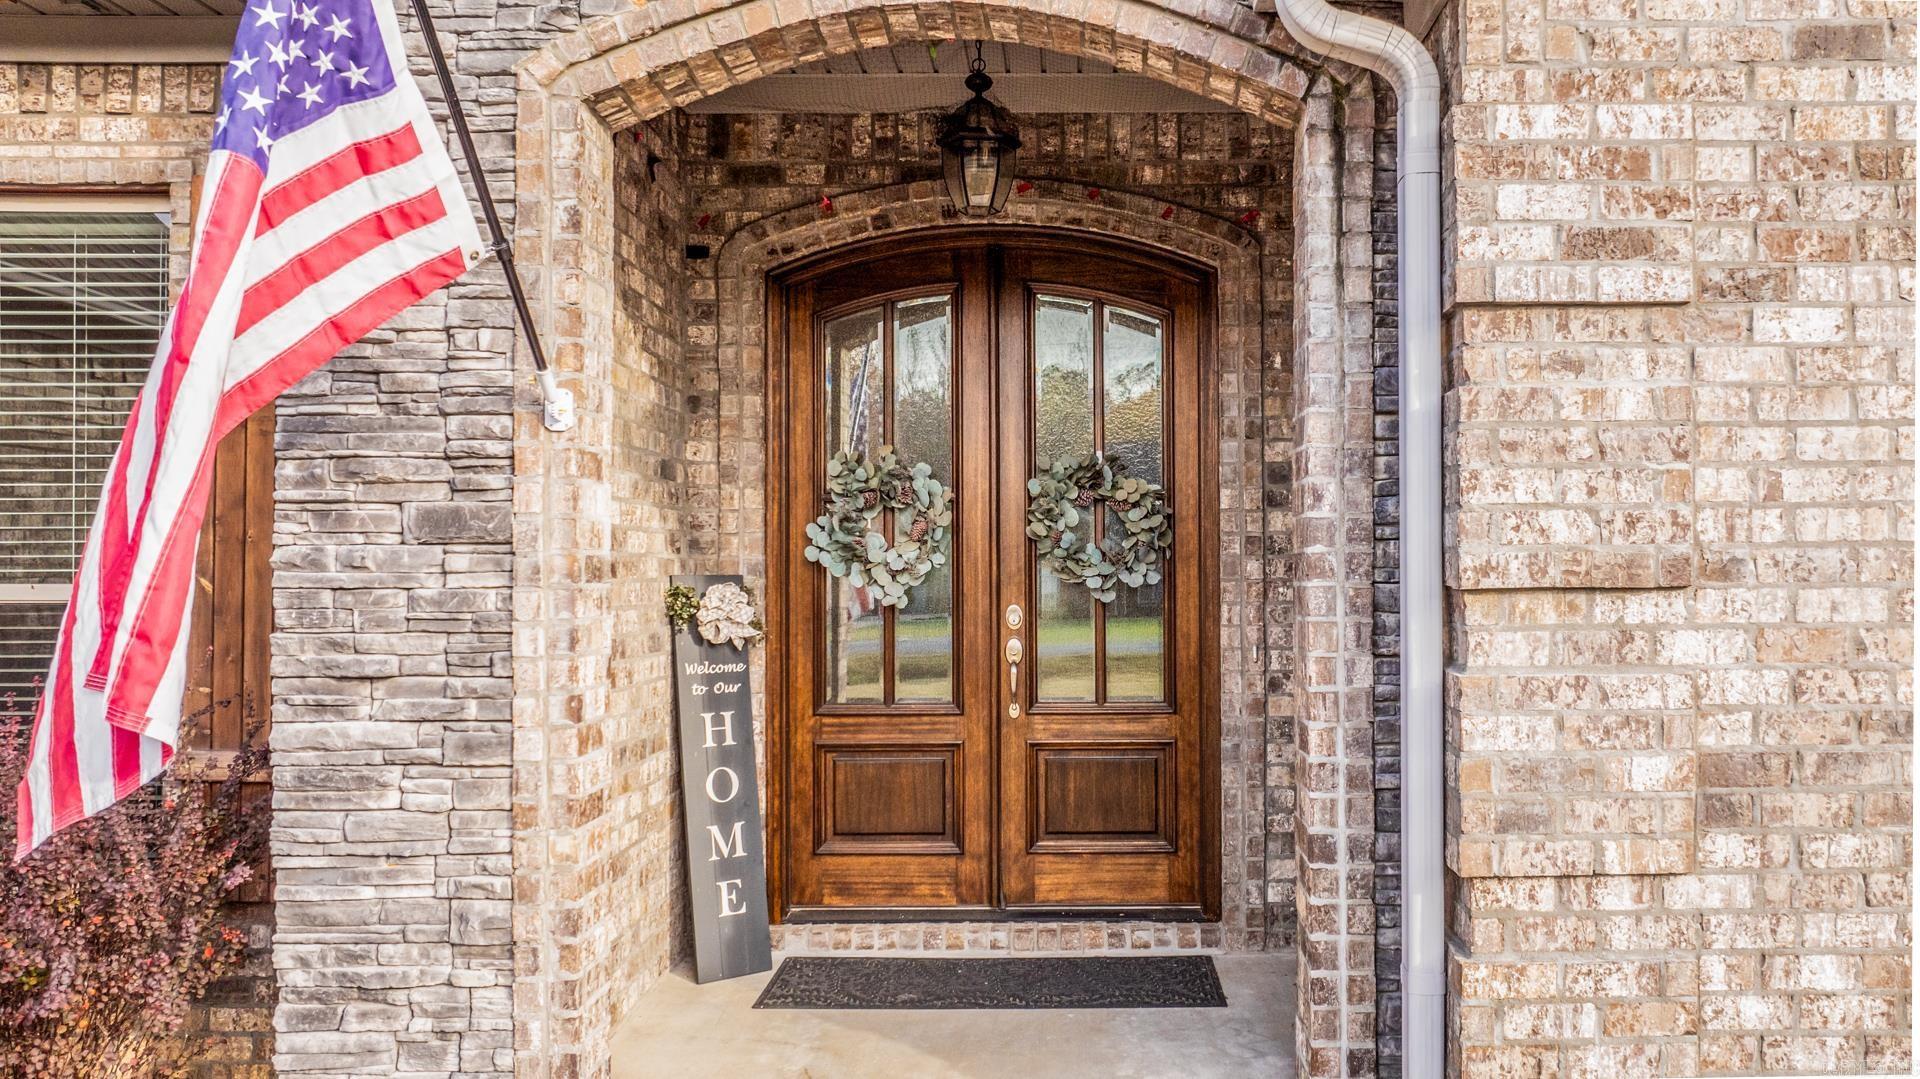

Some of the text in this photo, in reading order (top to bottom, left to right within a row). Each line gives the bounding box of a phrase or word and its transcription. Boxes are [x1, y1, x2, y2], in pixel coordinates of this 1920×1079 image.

[684, 661, 747, 675] Welcome
[691, 681, 742, 695] to Our
[700, 710, 748, 918] HOME
